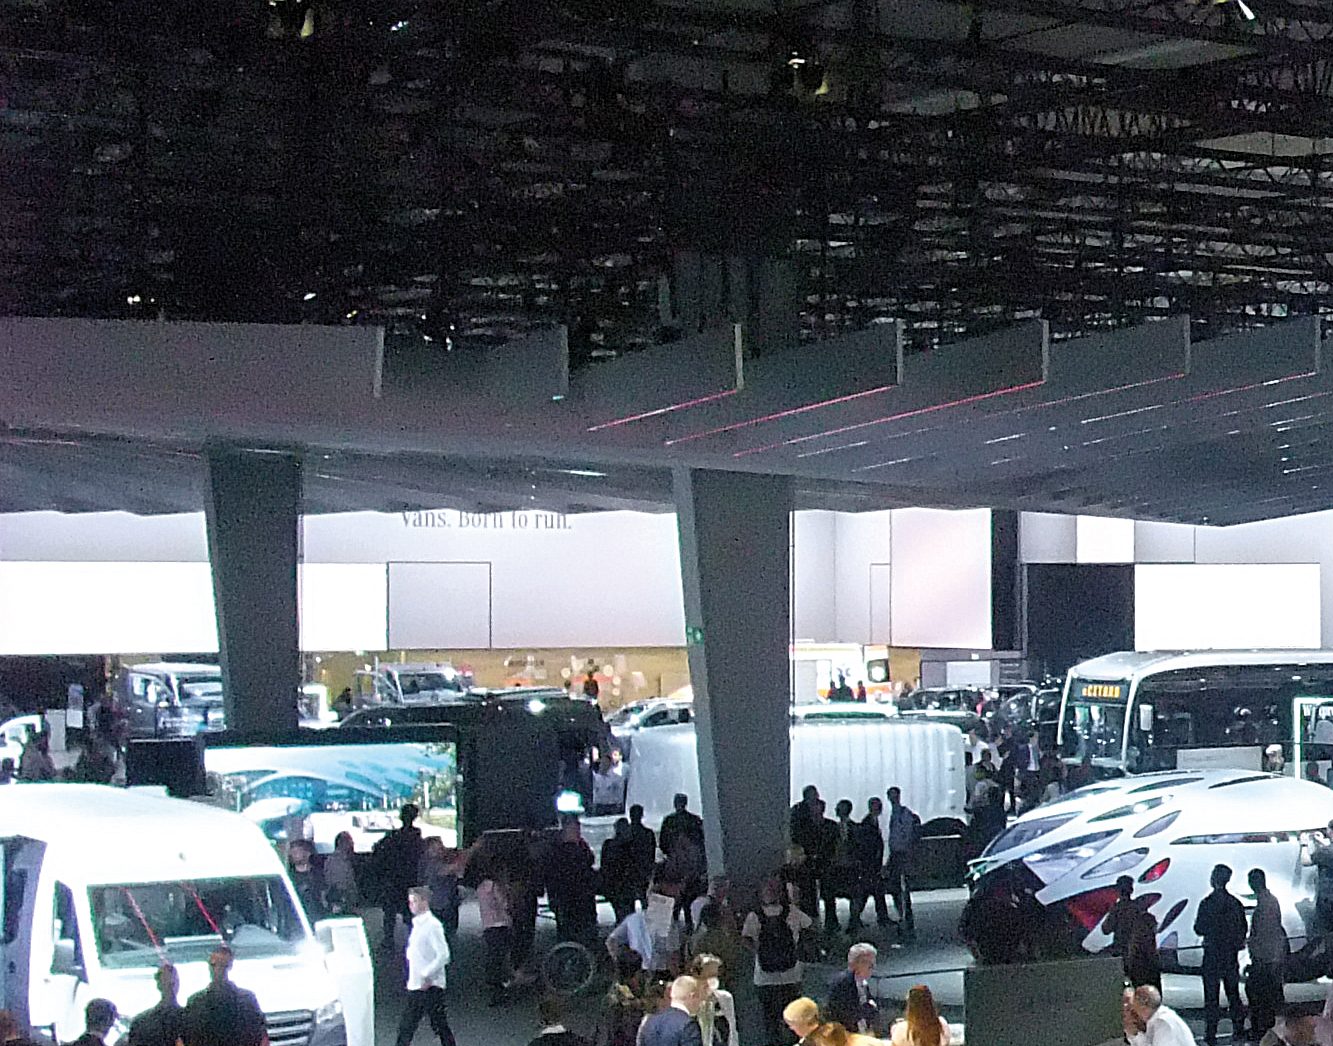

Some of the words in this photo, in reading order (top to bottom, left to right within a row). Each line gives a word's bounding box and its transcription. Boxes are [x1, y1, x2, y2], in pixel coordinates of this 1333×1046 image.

[458, 511, 503, 528] Born
[511, 511, 529, 528] to
[535, 512, 572, 530] run.
